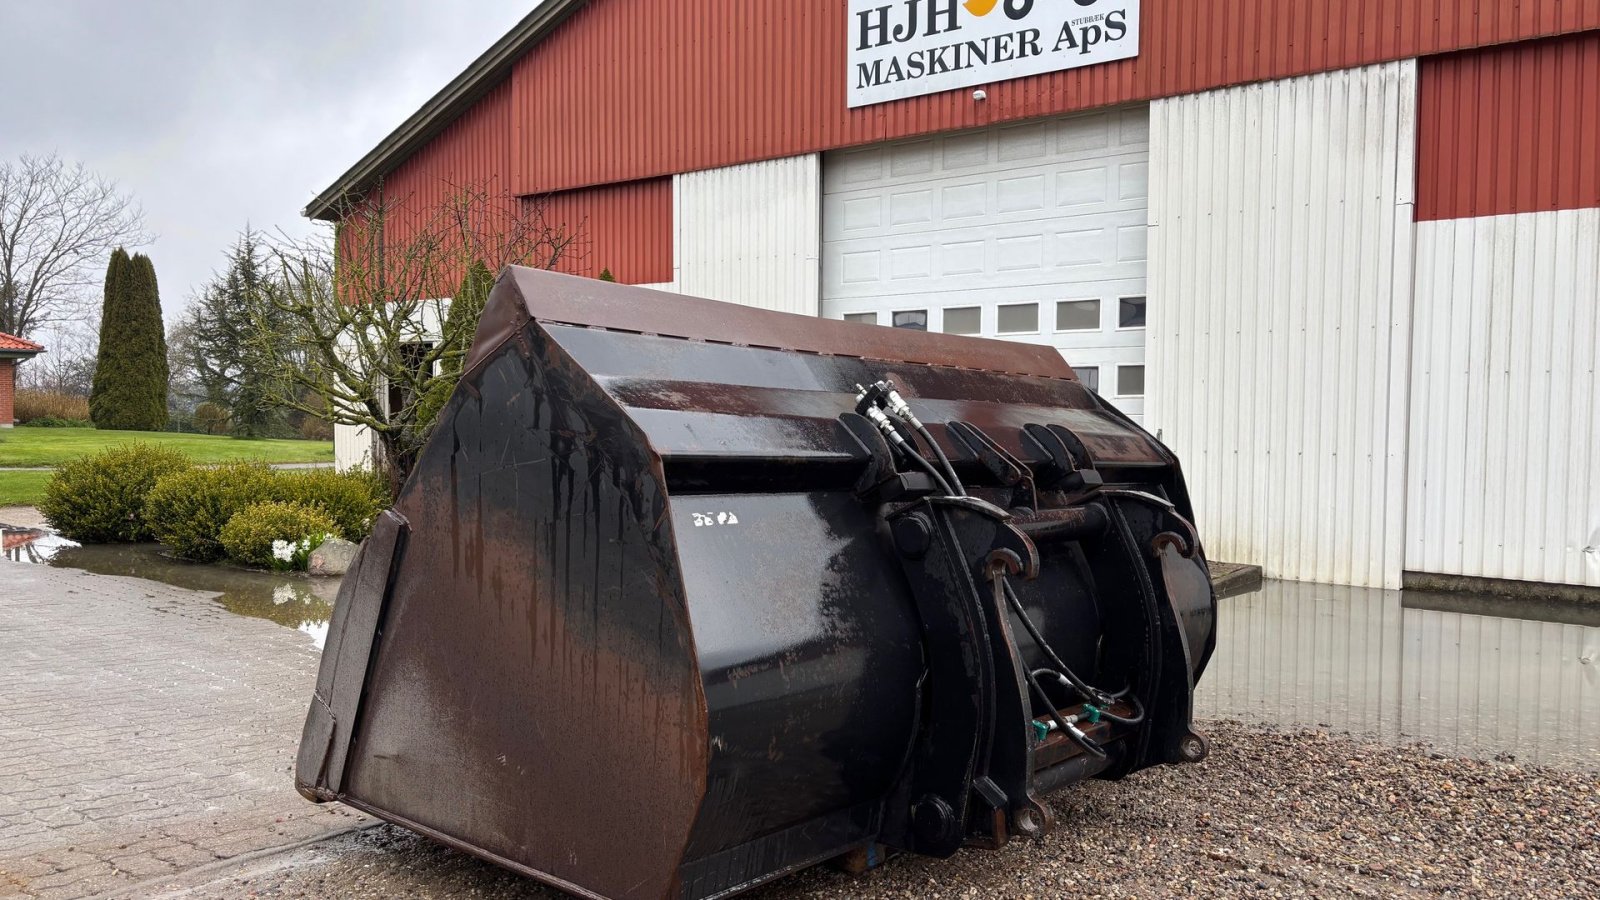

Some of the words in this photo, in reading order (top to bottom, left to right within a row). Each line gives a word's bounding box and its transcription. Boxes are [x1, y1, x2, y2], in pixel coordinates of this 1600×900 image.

[856, 0, 962, 51] HJH
[856, 28, 1043, 89] MASKINER
[1052, 8, 1127, 55] ApS
